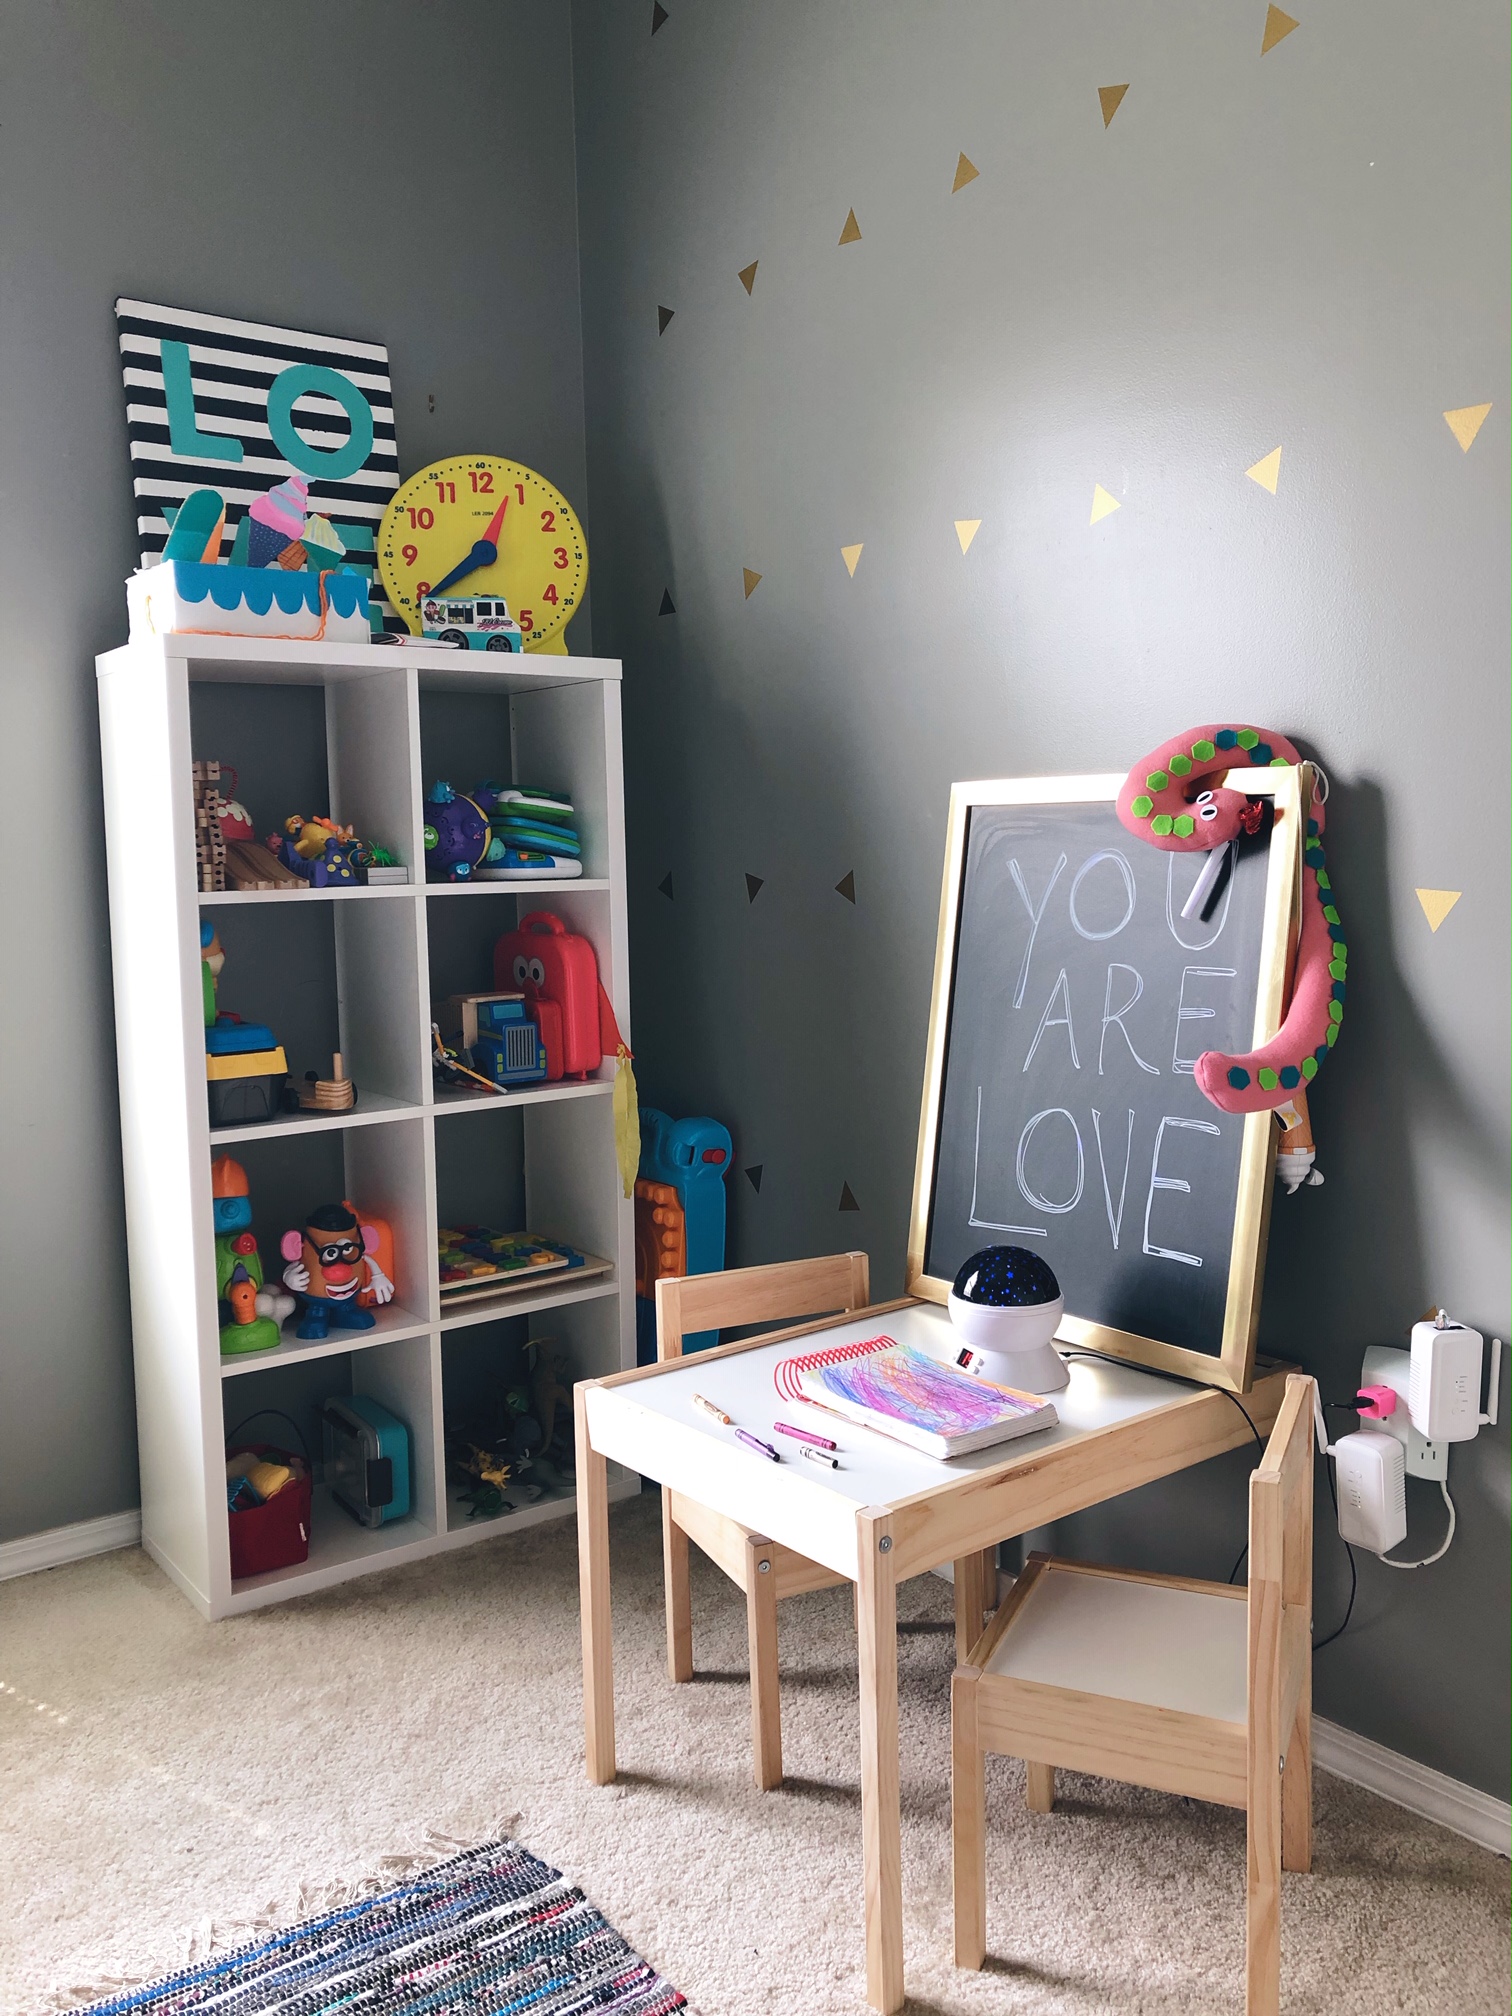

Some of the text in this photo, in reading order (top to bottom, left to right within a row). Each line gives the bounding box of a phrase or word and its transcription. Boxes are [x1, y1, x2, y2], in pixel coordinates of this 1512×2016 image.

[160, 340, 374, 480] LO
[475, 461, 486, 469] 60
[467, 470, 495, 495] 12
[524, 473, 531, 481] 5
[434, 481, 456, 504] 11
[514, 483, 525, 506] 1
[405, 507, 436, 531] 10
[540, 510, 557, 533] 2
[560, 507, 568, 515] 10
[401, 544, 419, 567] 9
[553, 546, 570, 570] 3
[574, 552, 583, 560] 15
[542, 582, 560, 606] 4
[564, 598, 574, 606] 20
[519, 609, 534, 632] 5
[532, 631, 542, 639] 25
[1006, 840, 1239, 1009] YOU
[1023, 963, 1238, 1075] ARE
[968, 1086, 1222, 1267] LOVE
